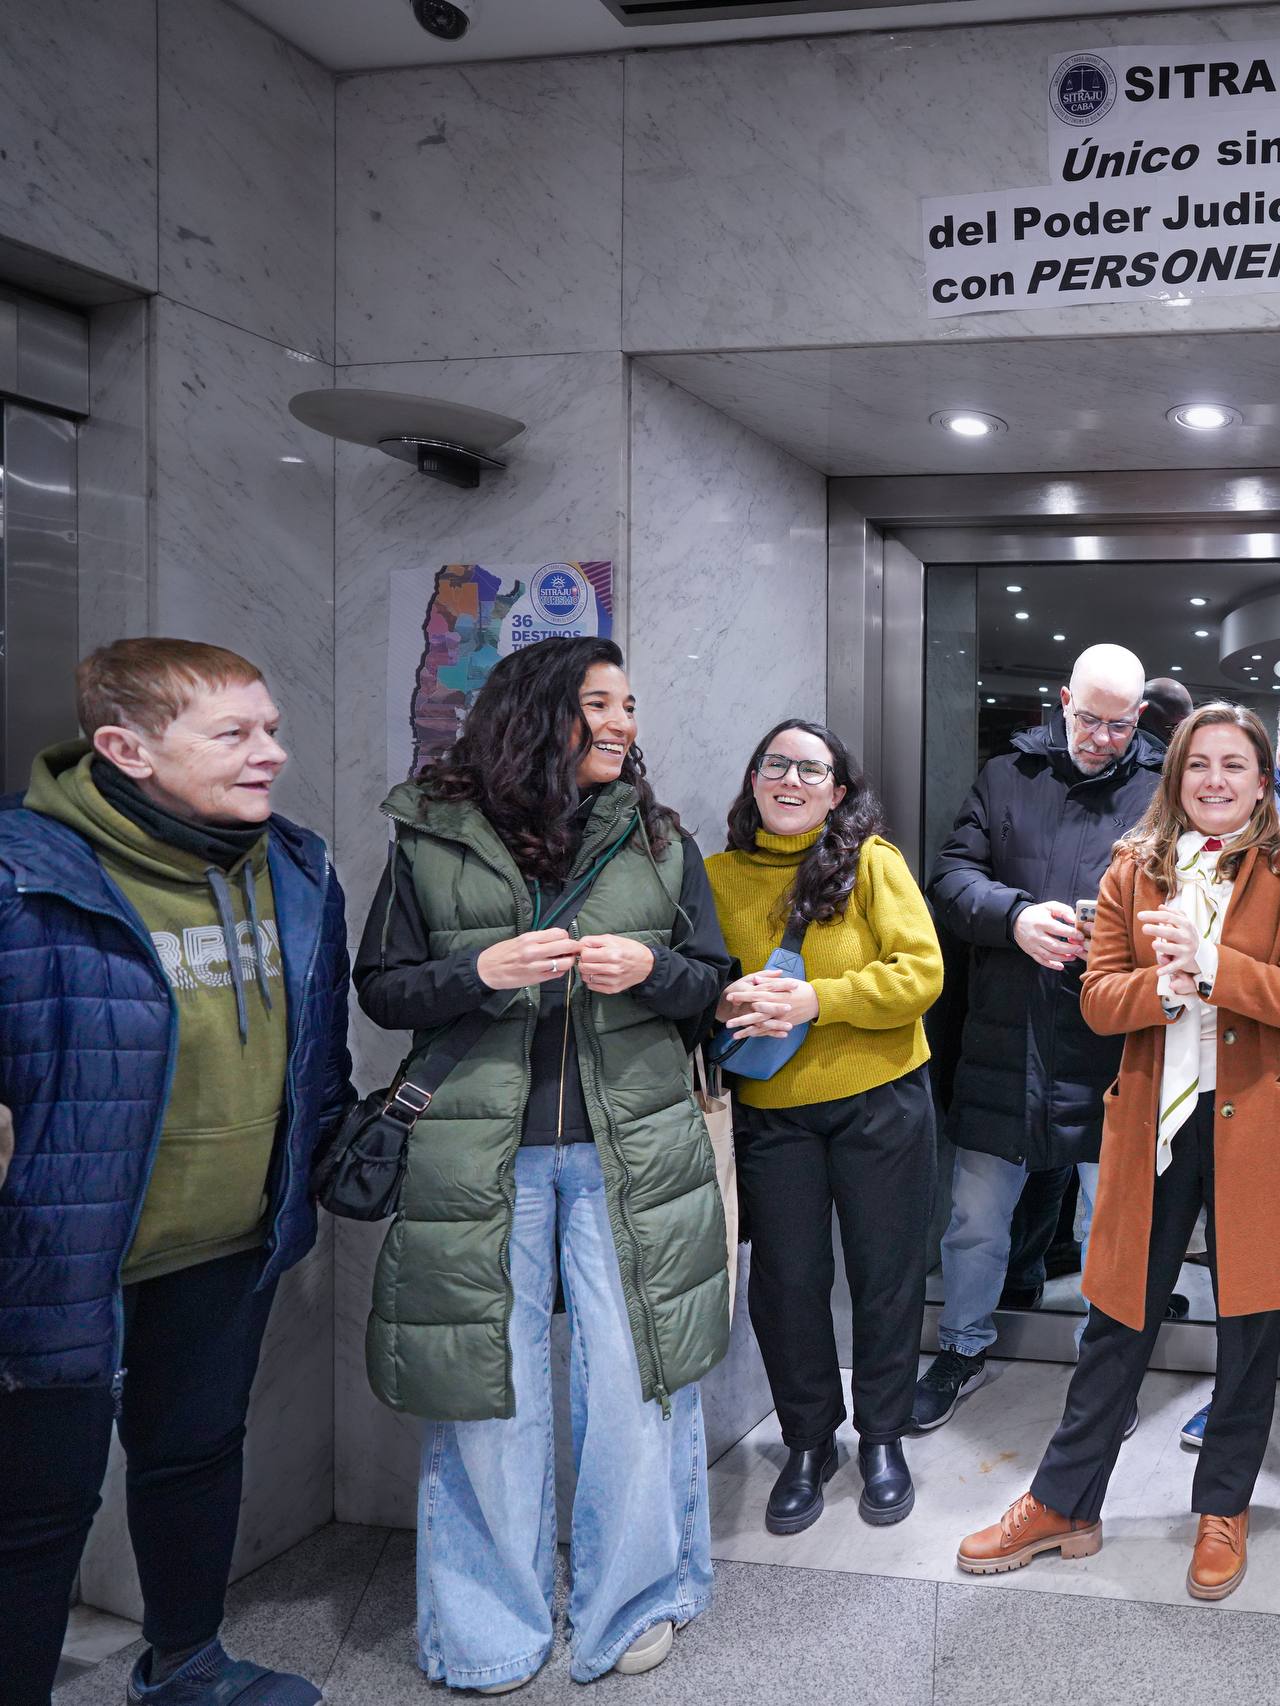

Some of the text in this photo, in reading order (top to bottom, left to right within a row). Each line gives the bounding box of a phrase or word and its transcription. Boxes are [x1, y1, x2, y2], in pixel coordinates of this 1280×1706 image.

[1062, 90, 1103, 104] SITRAJU
[1071, 102, 1094, 112] CABA
[1062, 137, 1200, 182] Único
[928, 210, 997, 250] del
[1013, 201, 1152, 241] Poder
[931, 271, 1015, 305] con
[540, 588, 572, 596] SITRAJU
[540, 595, 579, 606] TURISMO
[512, 615, 533, 627] 36
